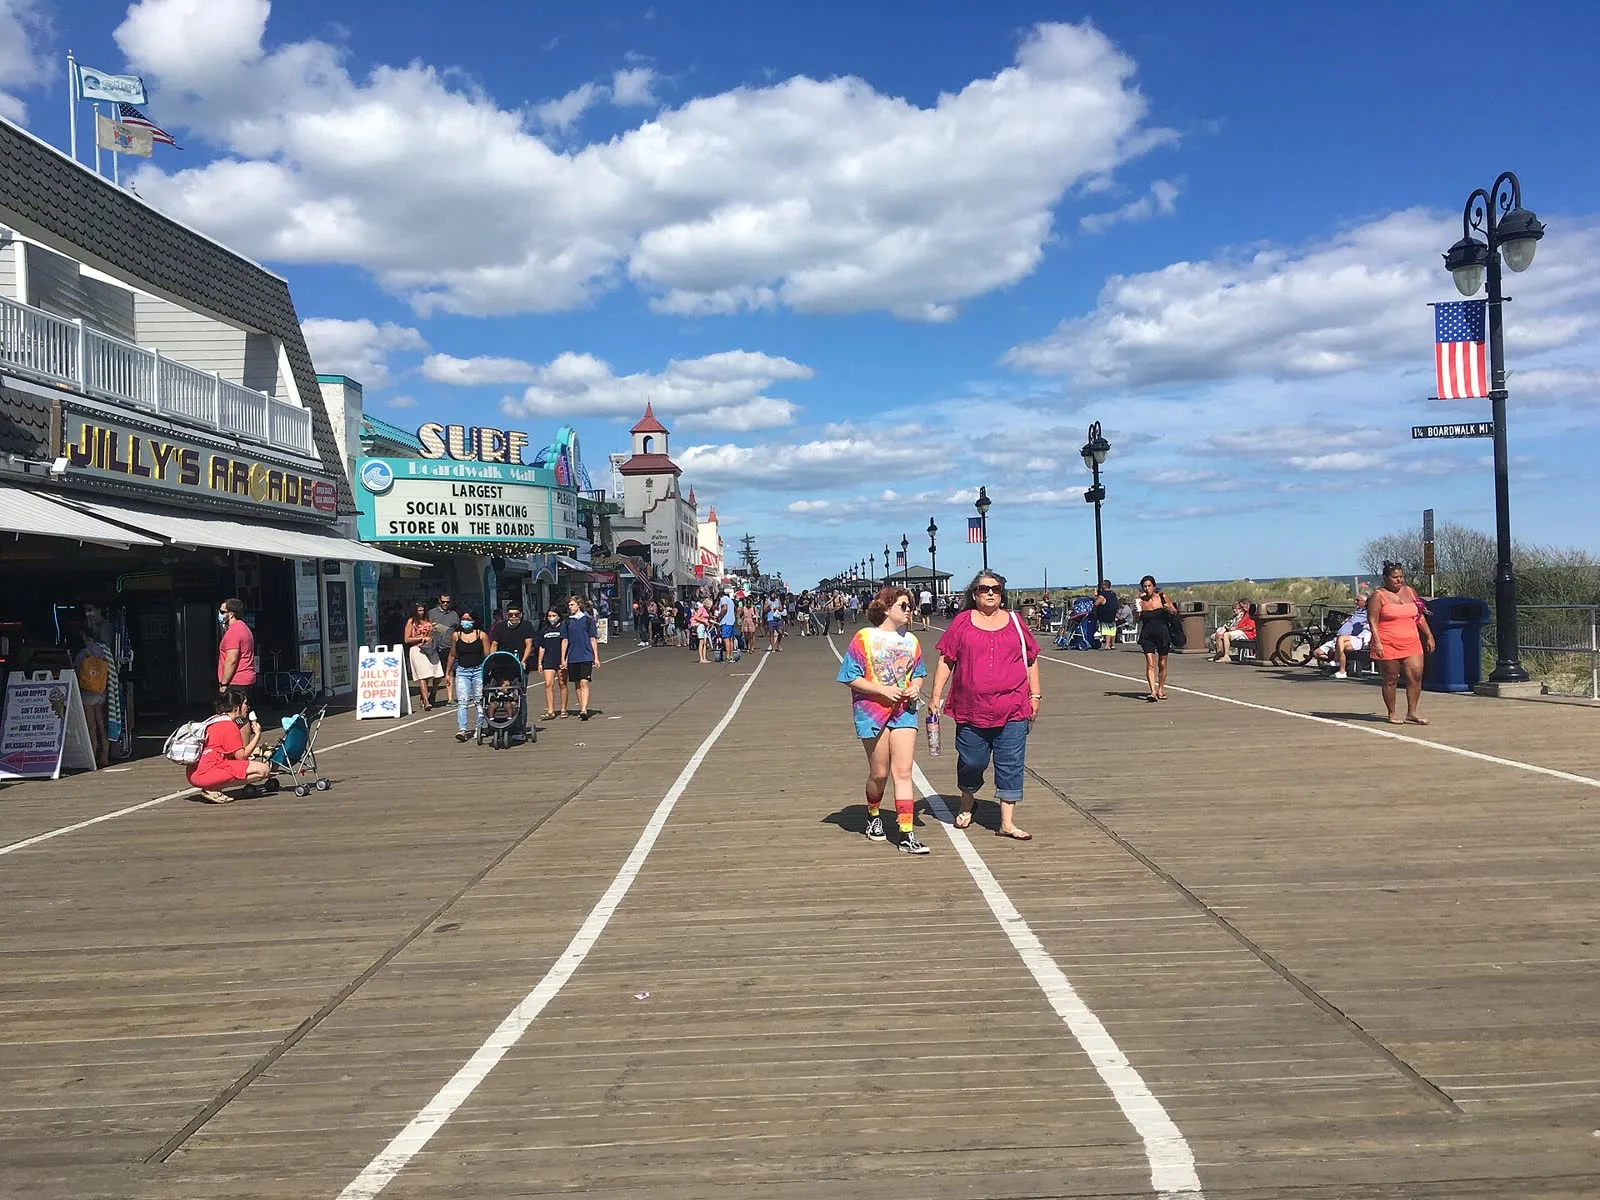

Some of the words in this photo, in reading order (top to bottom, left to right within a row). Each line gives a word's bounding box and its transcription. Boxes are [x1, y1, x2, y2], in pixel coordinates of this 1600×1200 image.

[1427, 424, 1476, 437] BOARDWALK
[417, 422, 529, 465] SURF
[66, 423, 201, 486] JILLY'S
[208, 455, 312, 508] ARCADE
[408, 461, 503, 480] Boardwalk
[510, 468, 536, 482] Mall
[452, 483, 503, 499] LARGEST
[406, 501, 457, 516] SOCIAL
[465, 503, 528, 518] DISTANCING
[389, 520, 436, 535] STORE
[441, 521, 459, 535] ON
[470, 522, 491, 535] THE
[496, 523, 535, 537] BOARDS
[360, 669, 400, 679] JILLY'S
[360, 679, 399, 688] ARCADE
[362, 689, 396, 699] OPEN
